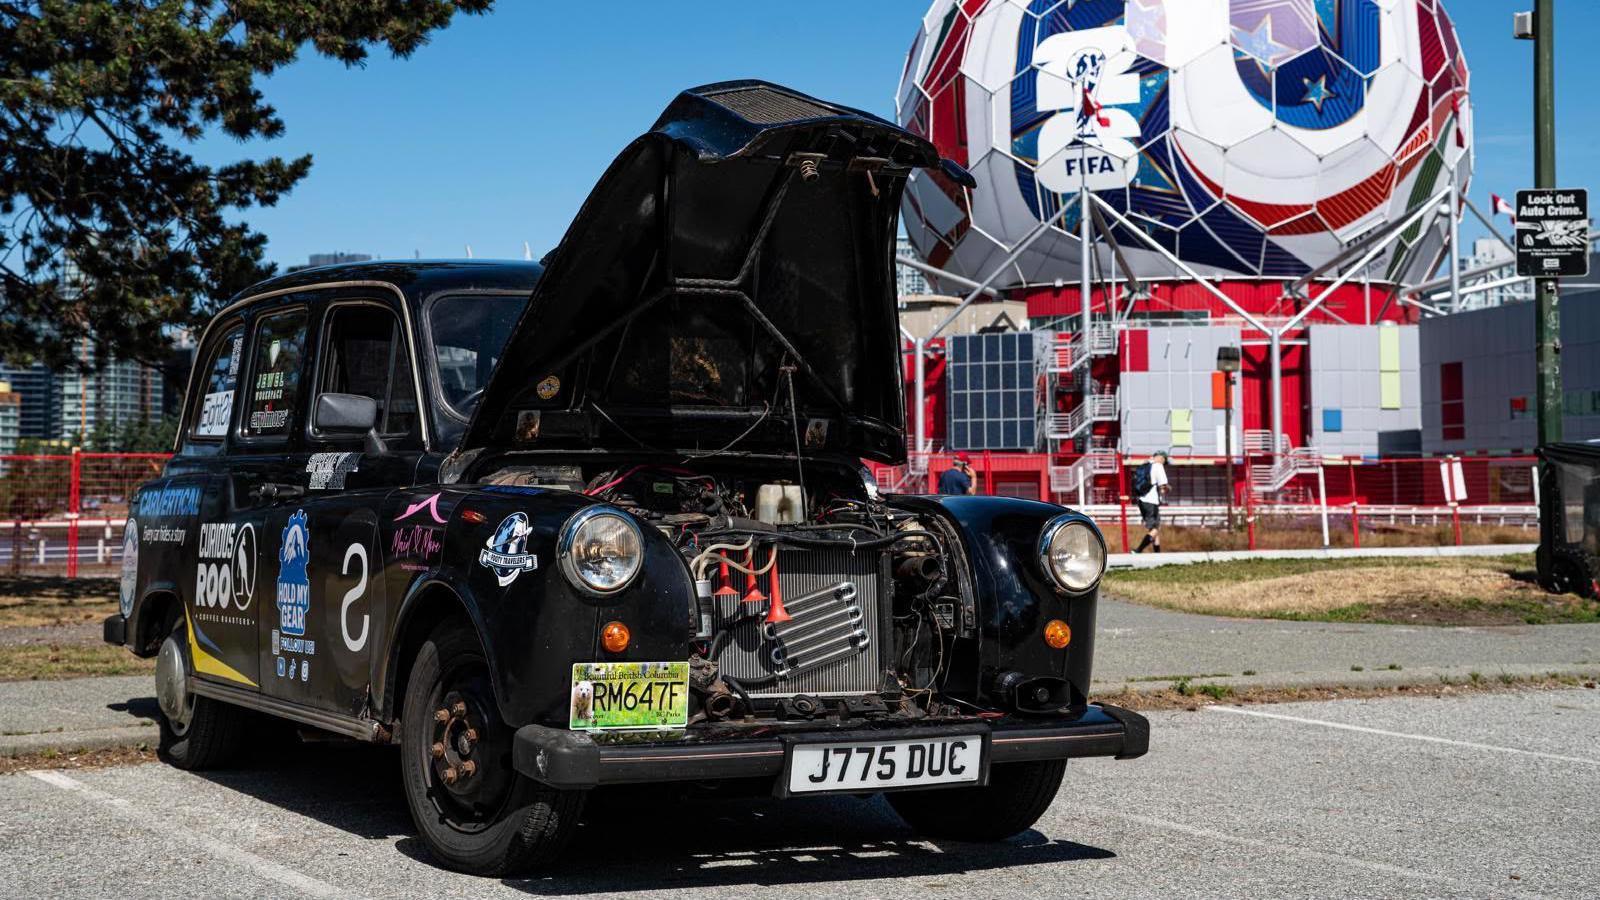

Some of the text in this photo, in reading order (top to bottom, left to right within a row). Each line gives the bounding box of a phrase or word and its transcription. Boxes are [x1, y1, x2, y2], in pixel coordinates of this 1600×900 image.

[1065, 155, 1115, 176] FIFA
[1528, 193, 1575, 205] Lock Out
[1520, 205, 1583, 216] Auto Crime.
[256, 371, 284, 389] JEWEL
[198, 523, 236, 559] CURIOUS
[196, 563, 231, 609] ROO
[278, 582, 308, 605] HOLD MY
[199, 613, 250, 626] COFFEE ROASTERS
[281, 604, 304, 629] GEAR
[280, 636, 304, 653] FOLLOW
[584, 670, 679, 680] Beautiful British Columbia
[592, 681, 684, 711] RM647F
[808, 741, 967, 783] J775 DUC
